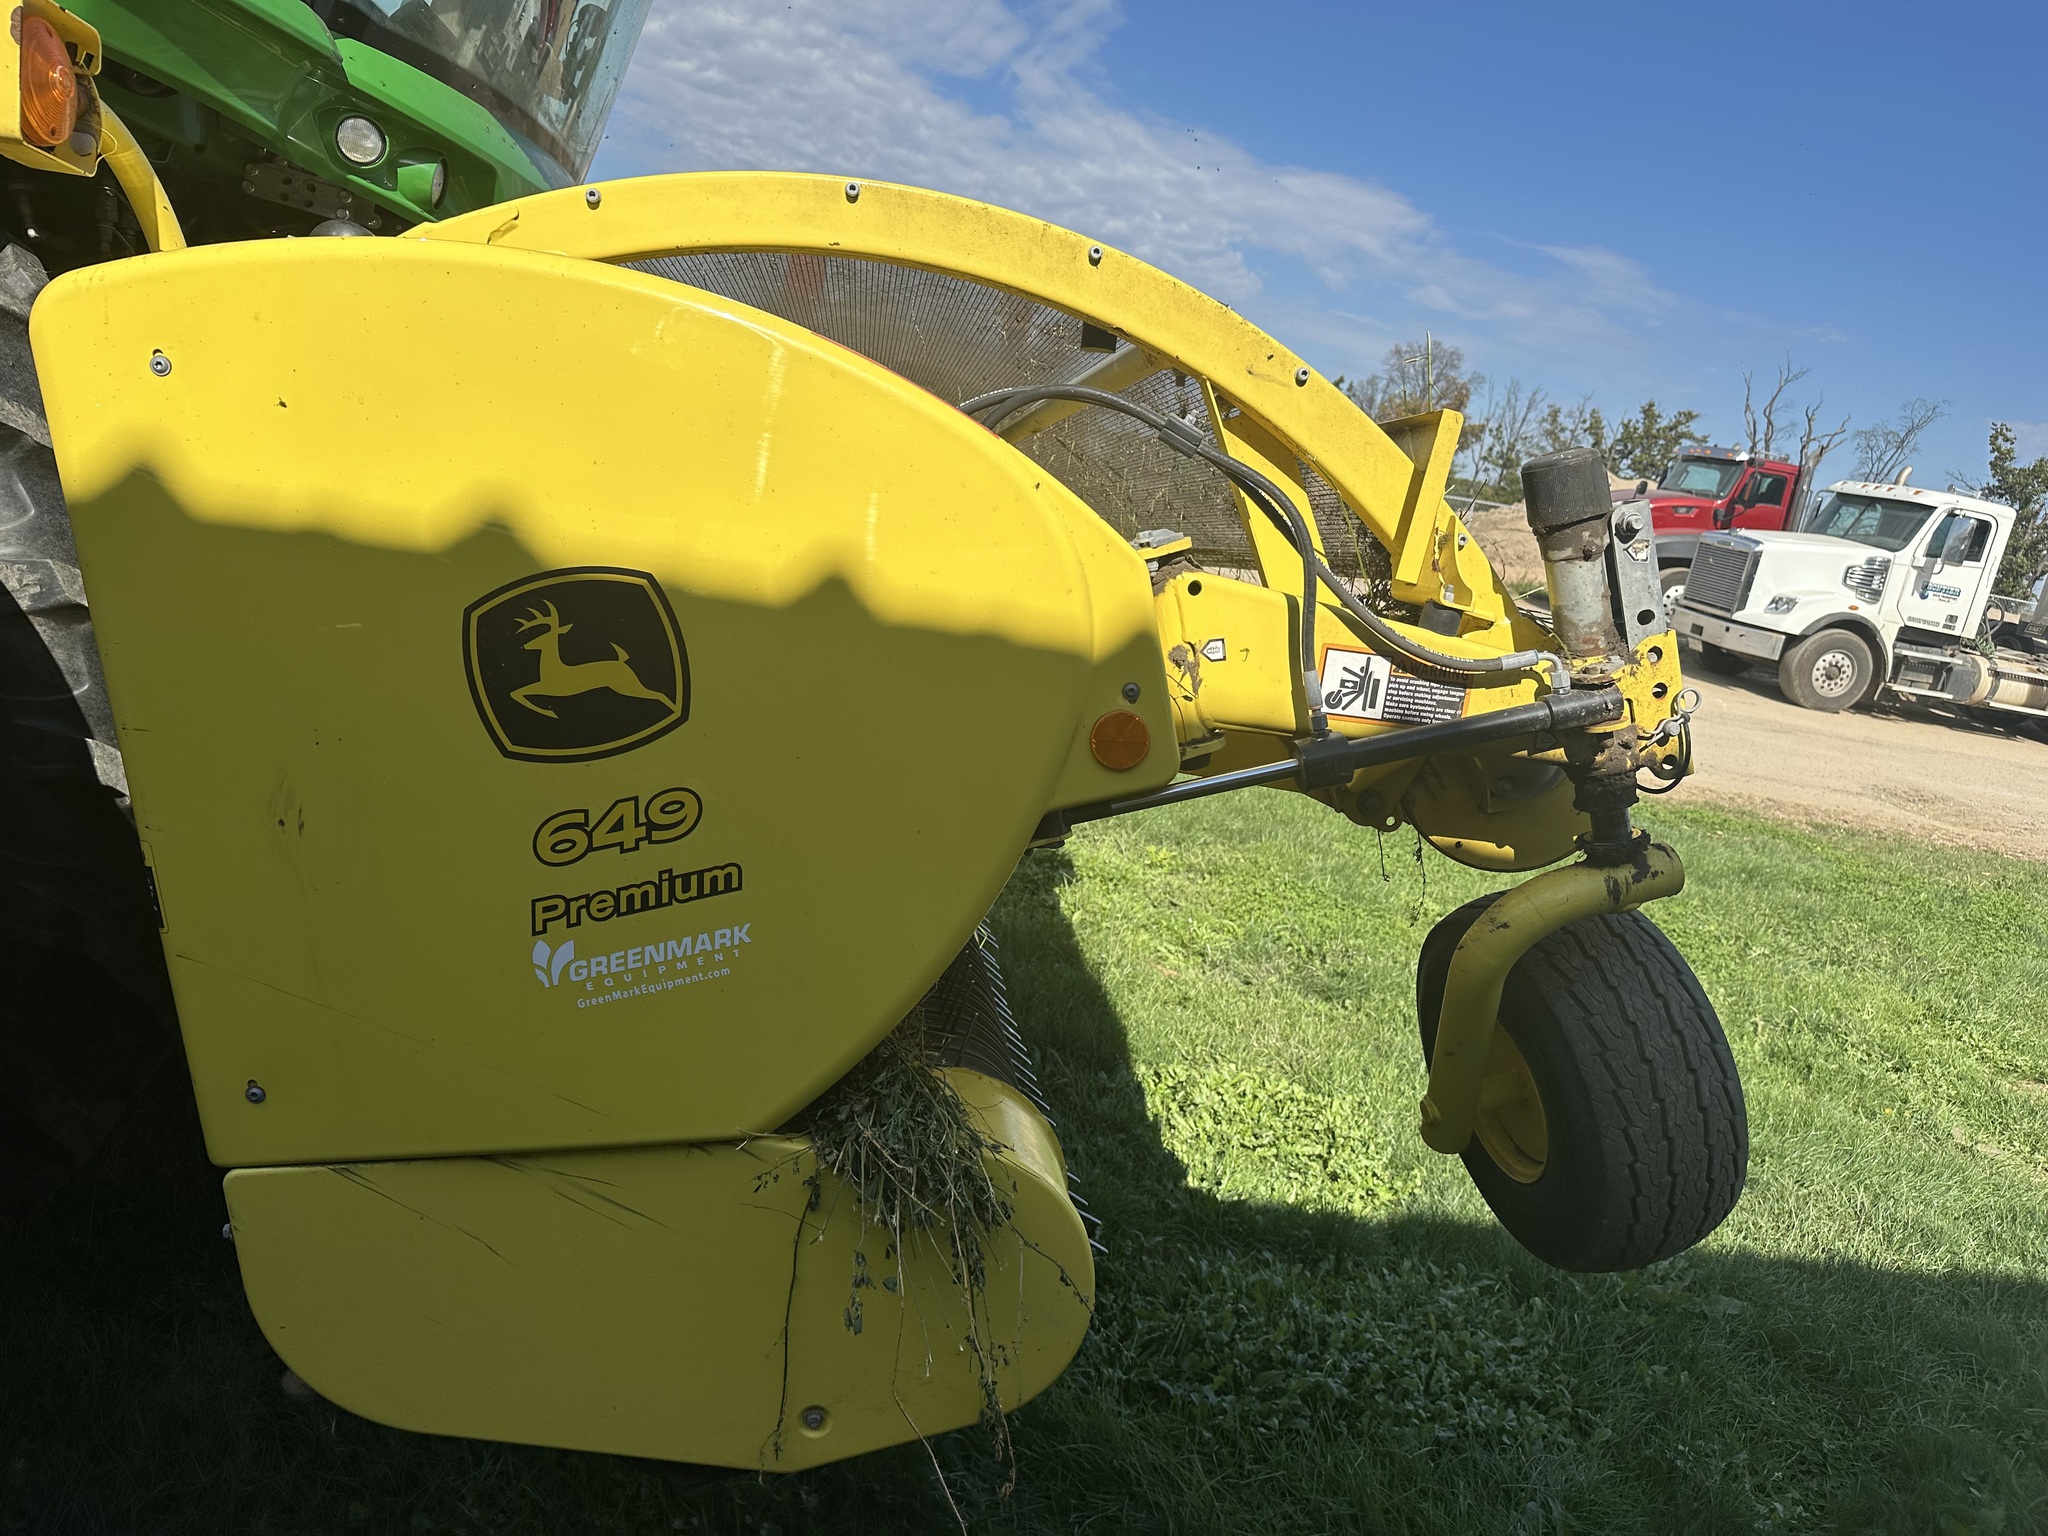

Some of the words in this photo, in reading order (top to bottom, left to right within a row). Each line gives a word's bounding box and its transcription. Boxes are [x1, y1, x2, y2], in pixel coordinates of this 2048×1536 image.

[1410, 661, 1469, 680] WARNING
[532, 787, 703, 867] 649
[531, 862, 743, 937] Premium
[569, 923, 752, 982] GREENMARK
[586, 949, 741, 991] EQUIPMENT
[577, 966, 731, 1009] GreenMarkEquipment.com
